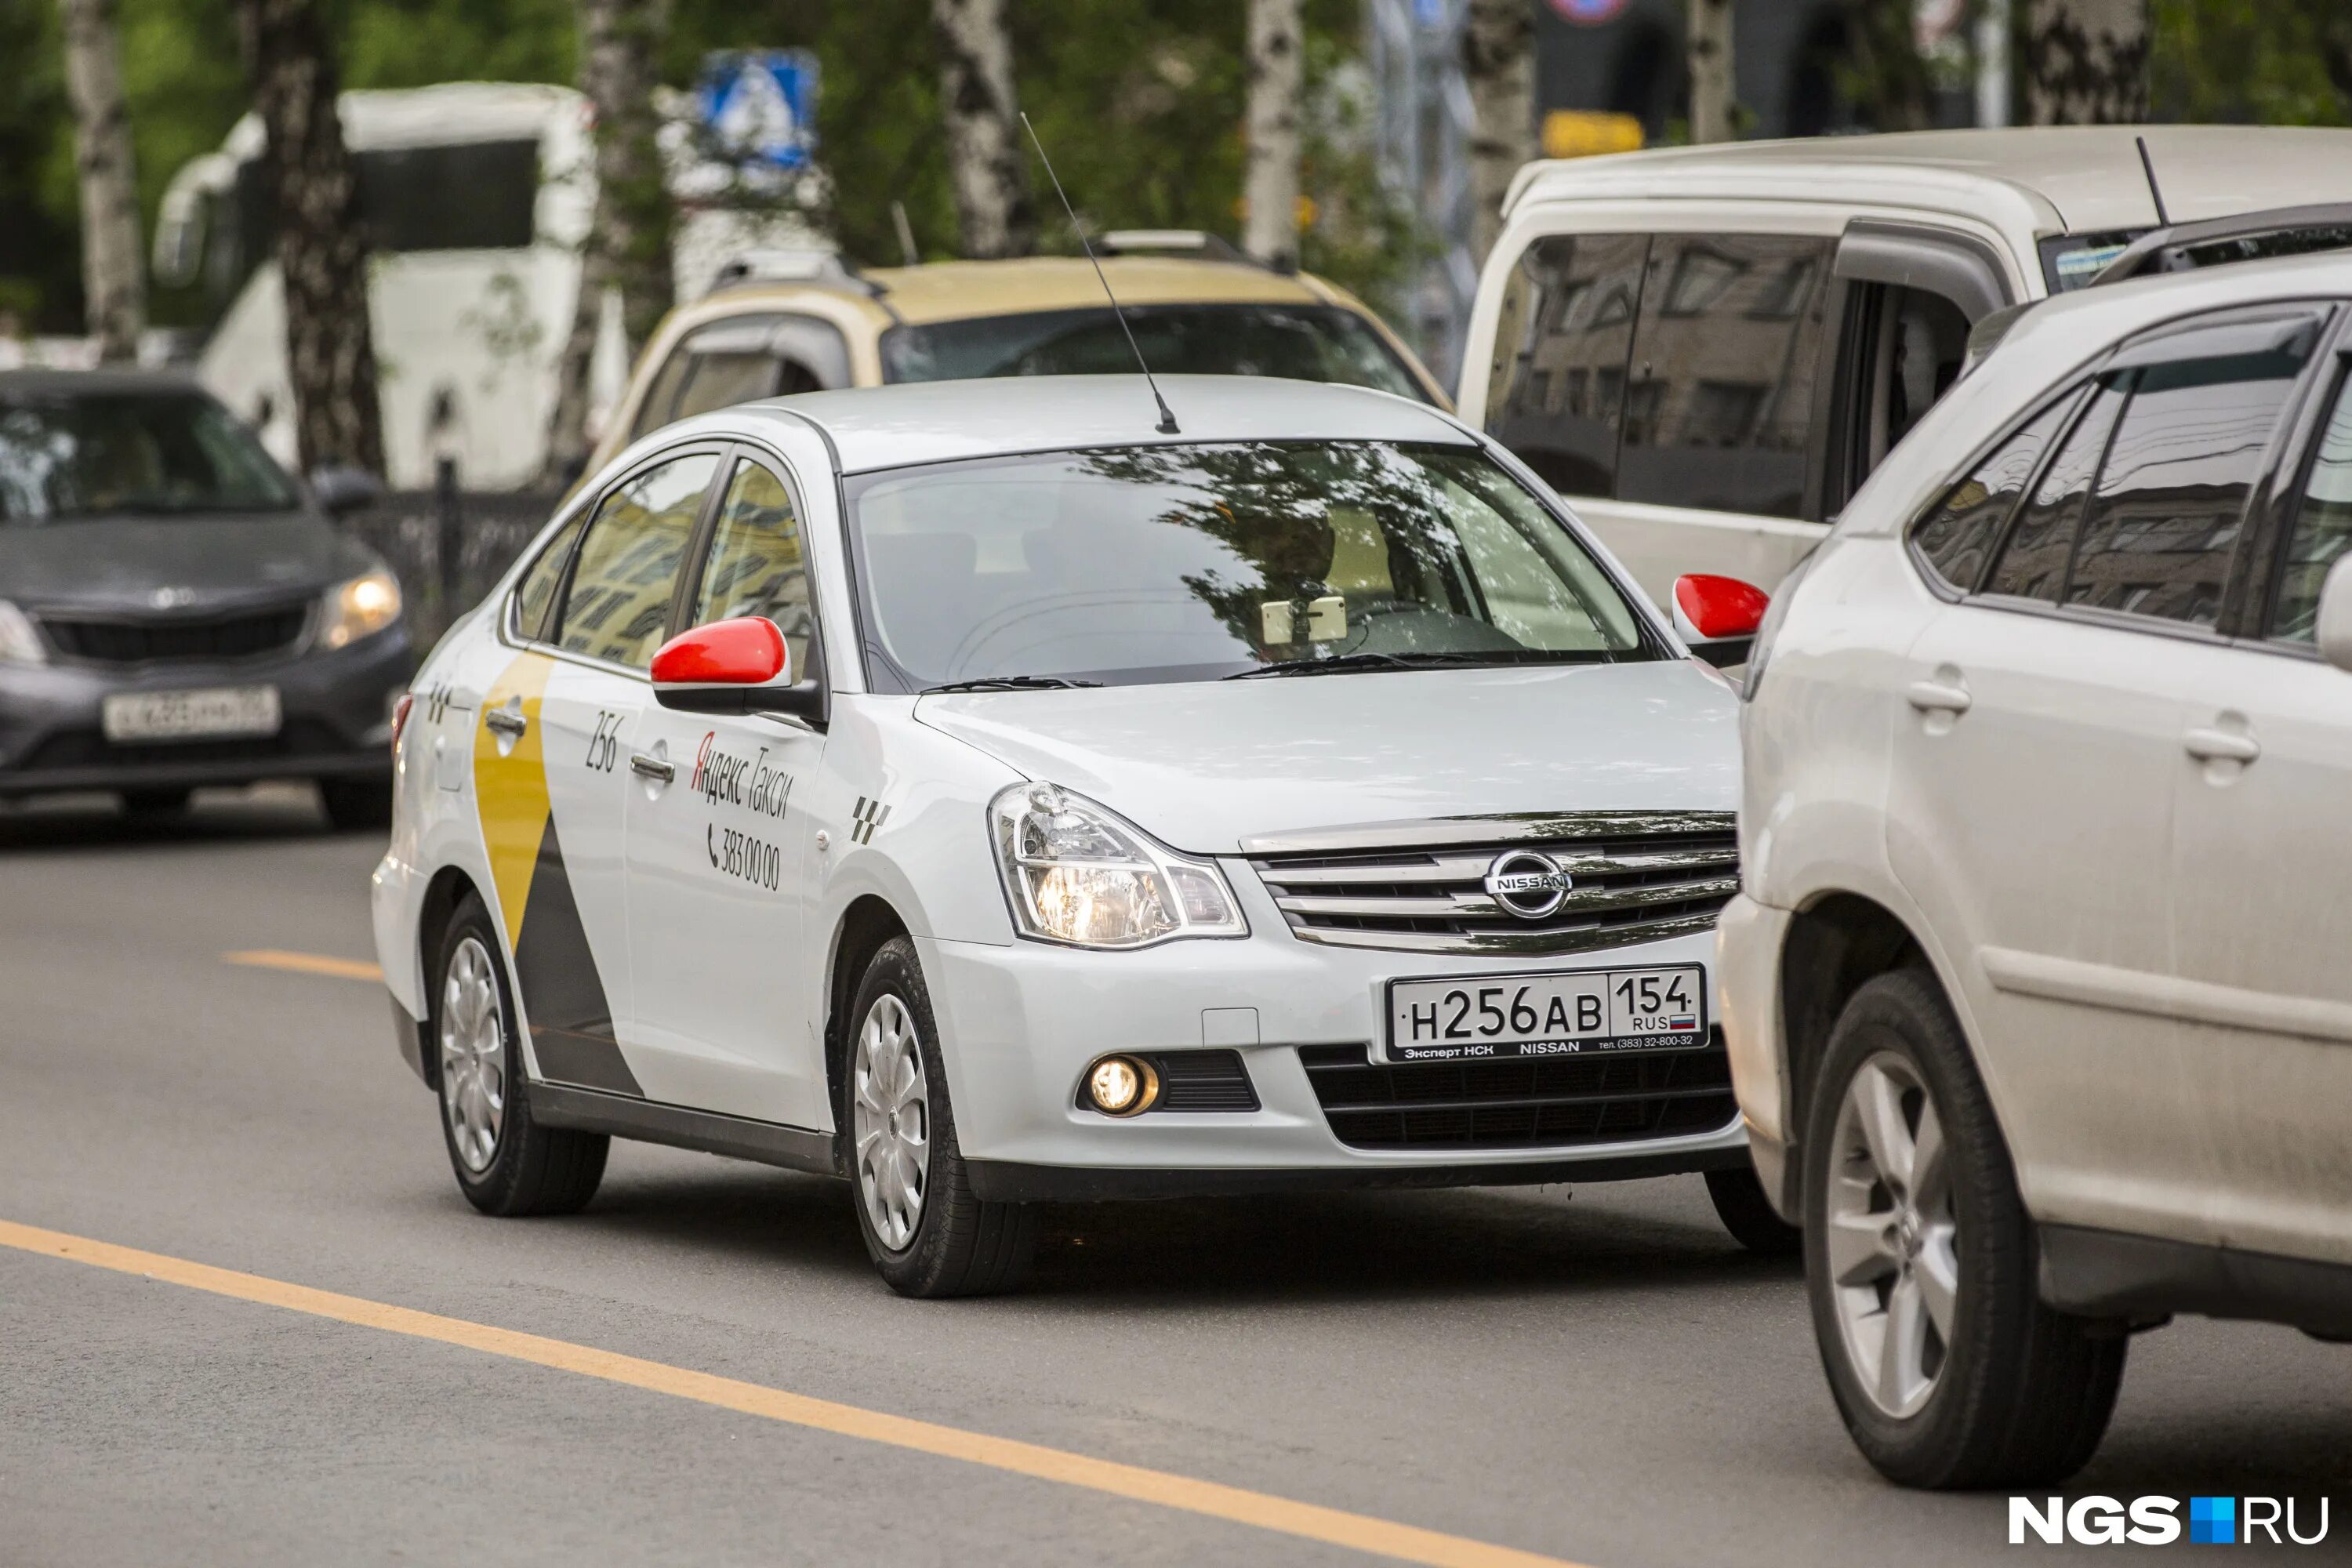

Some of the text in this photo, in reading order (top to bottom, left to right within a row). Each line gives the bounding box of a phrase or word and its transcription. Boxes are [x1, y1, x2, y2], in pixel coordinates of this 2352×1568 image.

[586, 710, 625, 773] 256
[691, 731, 793, 820] Яндекс Такси
[1497, 876, 1564, 890] NISSAN
[1615, 975, 1686, 1015] 154
[1632, 1016, 1668, 1031] RUS
[1519, 1041, 1580, 1054] NISSAN
[1617, 1038, 1642, 1050] (383)
[1644, 1035, 1693, 1047] 32-800-32
[1404, 1045, 1494, 1059] Эксперт НСК
